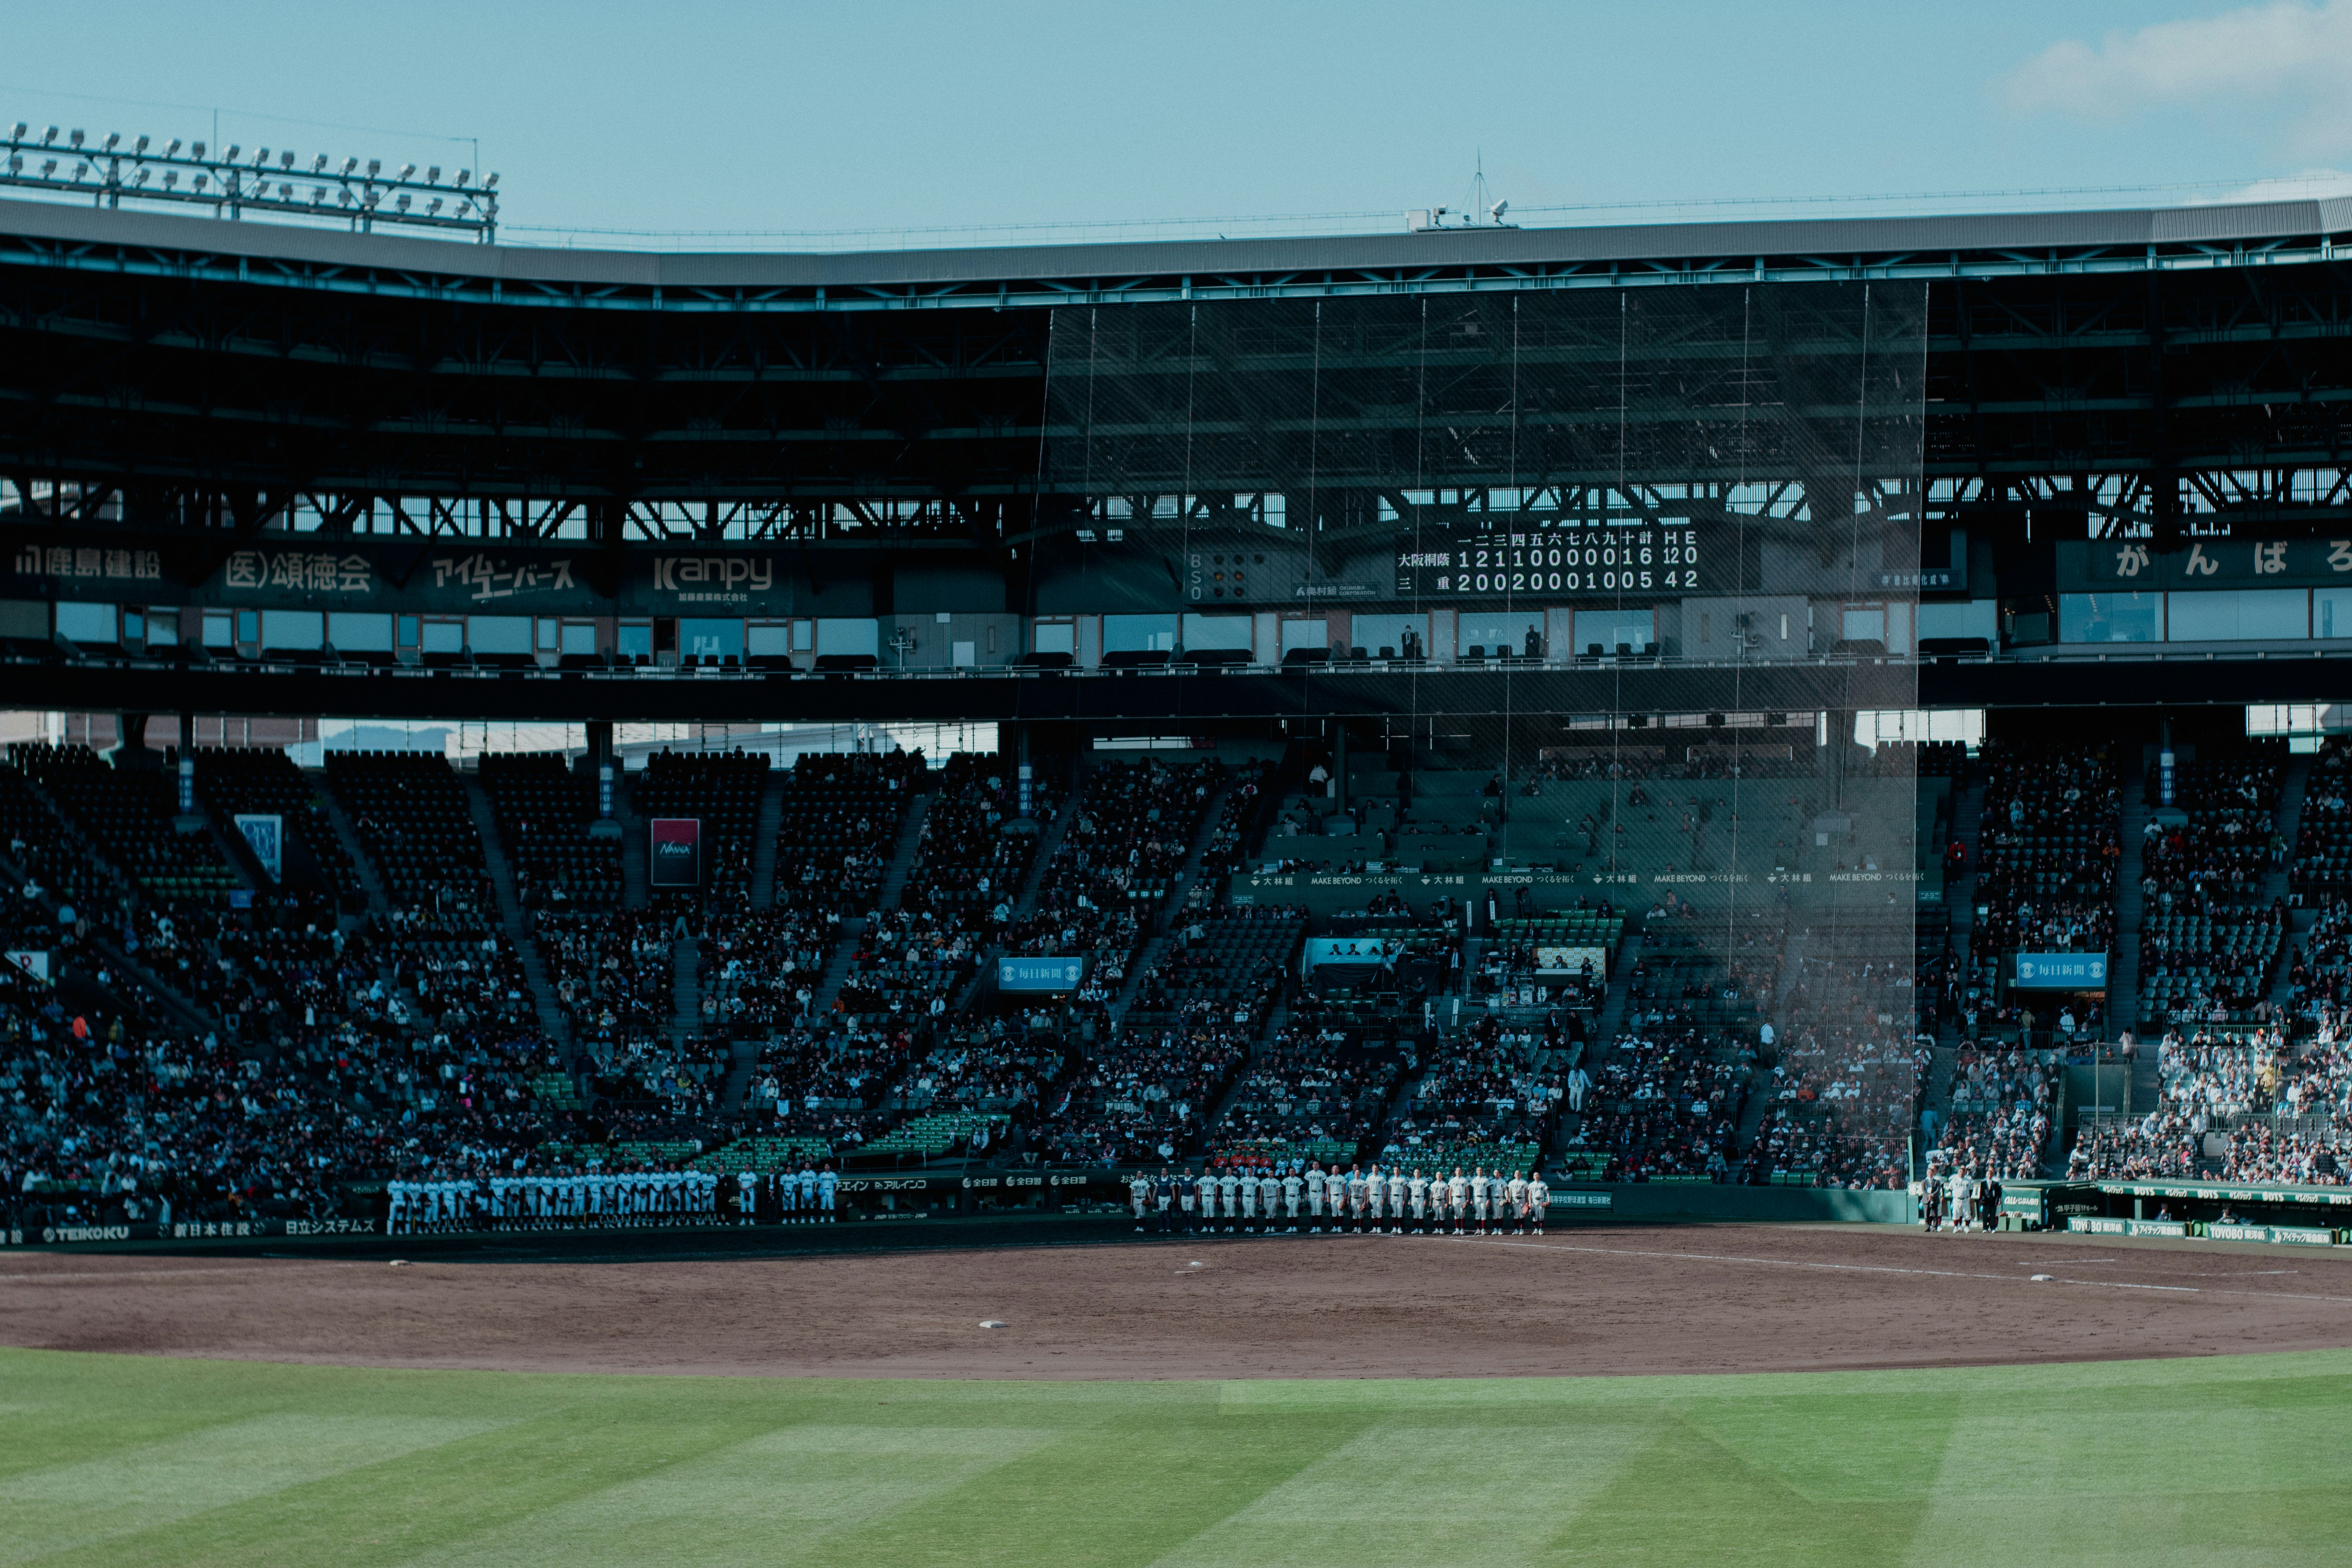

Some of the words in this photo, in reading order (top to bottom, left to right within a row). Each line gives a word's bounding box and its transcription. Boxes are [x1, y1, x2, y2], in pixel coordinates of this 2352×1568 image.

[1476, 535, 1489, 546] 二
[1494, 534, 1507, 546] 三
[1512, 534, 1525, 546] 四
[1530, 533, 1543, 546] 五
[1548, 533, 1561, 545] 六
[1566, 533, 1579, 545] 七
[1584, 532, 1598, 544] 八
[1603, 532, 1617, 545] 九
[1621, 531, 1635, 544] 十
[1640, 531, 1653, 544] 計
[1665, 532, 1677, 544] H
[1686, 531, 1696, 544] E
[1191, 554, 1201, 568] B
[1399, 553, 1450, 567] 大阪桐蔭
[1459, 552, 1469, 567] 1
[1476, 551, 1488, 567] 2
[1496, 551, 1505, 567] 1
[1514, 550, 1523, 566] 1
[1531, 550, 1542, 566] 0
[1549, 550, 1561, 566] 0
[1567, 549, 1579, 566] 0
[1585, 549, 1597, 565] 0
[1604, 548, 1615, 565] 0
[1623, 548, 1633, 564] 1
[1640, 548, 1651, 564] 6
[1664, 547, 1679, 564] 12
[1685, 547, 1697, 564] 0
[2116, 540, 2352, 577] がんばろ
[654, 557, 772, 590] Kanpy
[1191, 570, 1202, 584] S
[1459, 575, 1470, 591] 2
[1477, 574, 1488, 591] 0
[1495, 574, 1506, 591] 0
[1513, 573, 1524, 590] 2
[1531, 573, 1542, 590] 0
[1549, 573, 1561, 590] 0
[1567, 573, 1579, 589] 0
[1587, 573, 1596, 589] 1
[1604, 572, 1615, 588] 0
[1622, 572, 1633, 588] 0
[1641, 572, 1652, 588] 5
[1665, 571, 1677, 587] 4
[1685, 571, 1697, 587] 2
[1306, 586, 1337, 596] 奥村組
[678, 592, 748, 603] 加藤産業株式会社
[659, 840, 690, 855] NANGA
[1263, 877, 1294, 886] 大林組
[1434, 876, 1464, 884] 大林組
[1606, 875, 1637, 883] 大林組
[1710, 874, 1748, 882] つくるを拓く
[1780, 873, 1811, 882] 大林組
[1886, 872, 1924, 881] つくるを拓く
[1019, 968, 1062, 979] 毎日新聞
[2039, 964, 2085, 976] 毎日新聞
[884, 1180, 927, 1190] アルインコ
[973, 1178, 998, 1187] 全日警
[1016, 1177, 1042, 1185] 全日警
[1061, 1176, 1087, 1185] 全日警
[1588, 1196, 1611, 1204] 毎日新聞社
[285, 1219, 376, 1235] 日立システムズ
[2071, 1220, 2102, 1232] TOYOBO
[55, 1226, 130, 1241] TEIKOKU
[2210, 1227, 2243, 1240] TOYOBO
